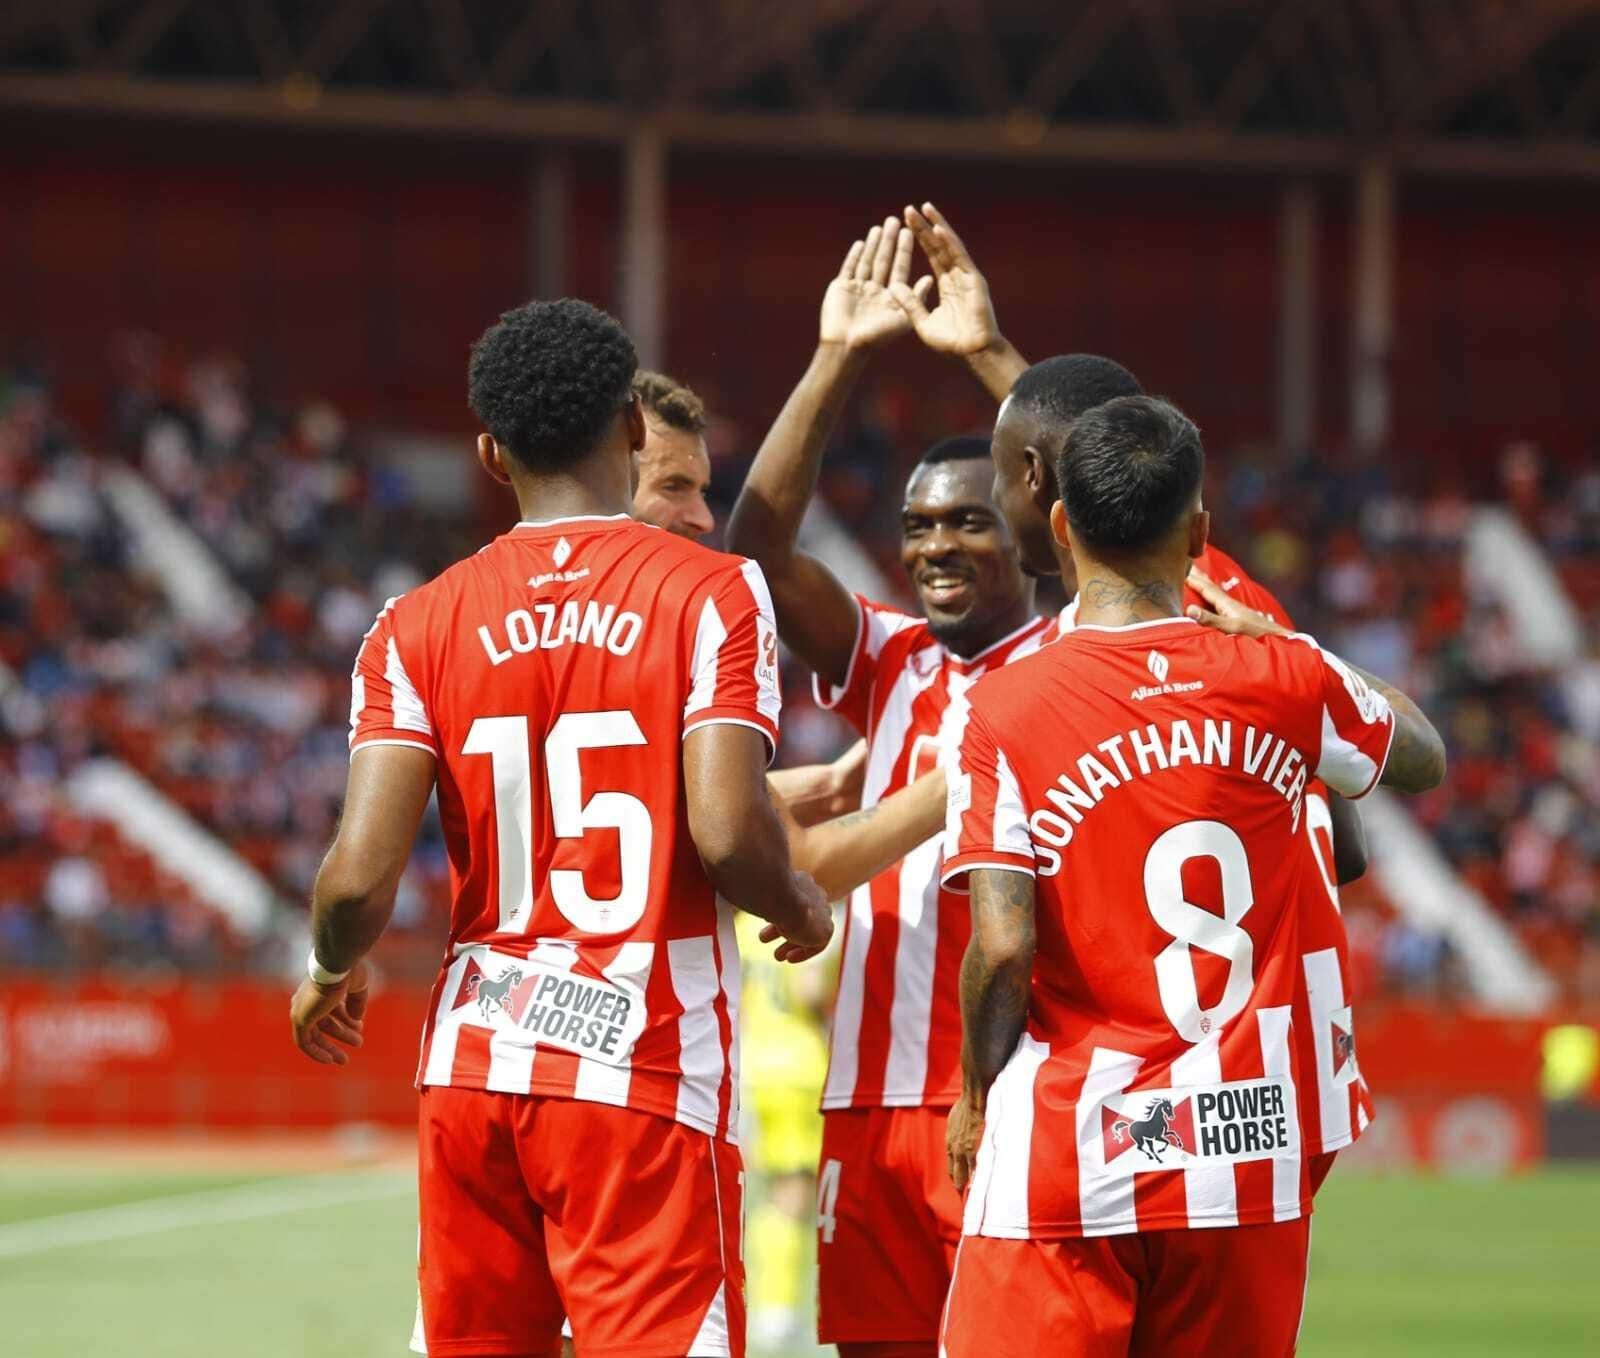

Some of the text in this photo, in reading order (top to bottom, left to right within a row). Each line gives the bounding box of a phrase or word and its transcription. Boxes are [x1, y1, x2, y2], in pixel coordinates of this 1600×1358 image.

[478, 600, 643, 666] LOZANO
[461, 709, 653, 935] 15
[1029, 719, 1232, 877] JONATHAN
[1143, 819, 1254, 1044] 8
[522, 1003, 623, 1056] HORSE
[537, 974, 631, 1026] POWER
[1197, 1084, 1285, 1124] POWER
[1201, 1117, 1288, 1157] HORSE
